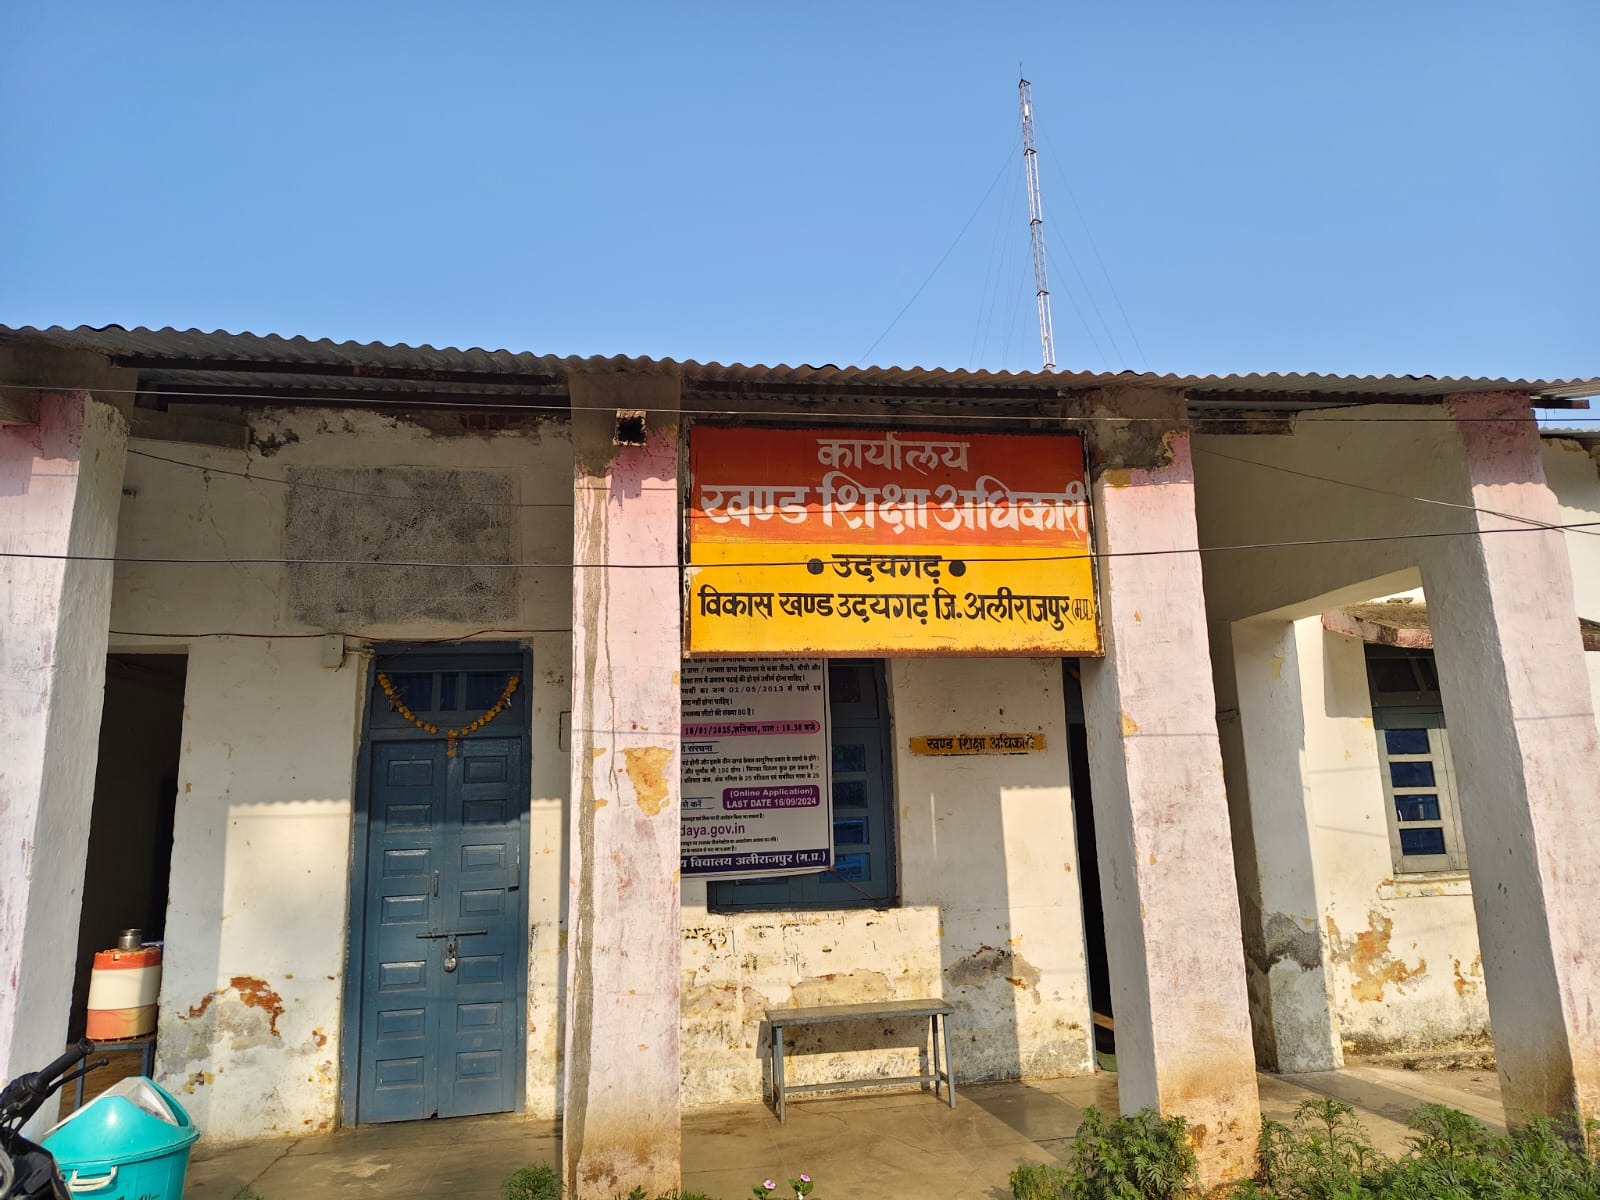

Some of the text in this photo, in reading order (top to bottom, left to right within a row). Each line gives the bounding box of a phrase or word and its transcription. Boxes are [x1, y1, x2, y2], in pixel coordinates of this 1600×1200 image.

[816, 432, 970, 475] कार्यालय
[701, 470, 1087, 538] खण्ड शिक्षा अधिकारी
[832, 554, 942, 584] उदयगढ़
[697, 584, 773, 618] विकास
[779, 592, 834, 617] खण्ड
[838, 593, 929, 624] उदयगढ़
[927, 738, 953, 750] खण्ड
[958, 734, 985, 752] शिक्षा
[726, 797, 817, 809] LAST DATE 16/09/2024
[730, 785, 813, 798] (Online Application)
[735, 852, 793, 866] अलीराजपुर
